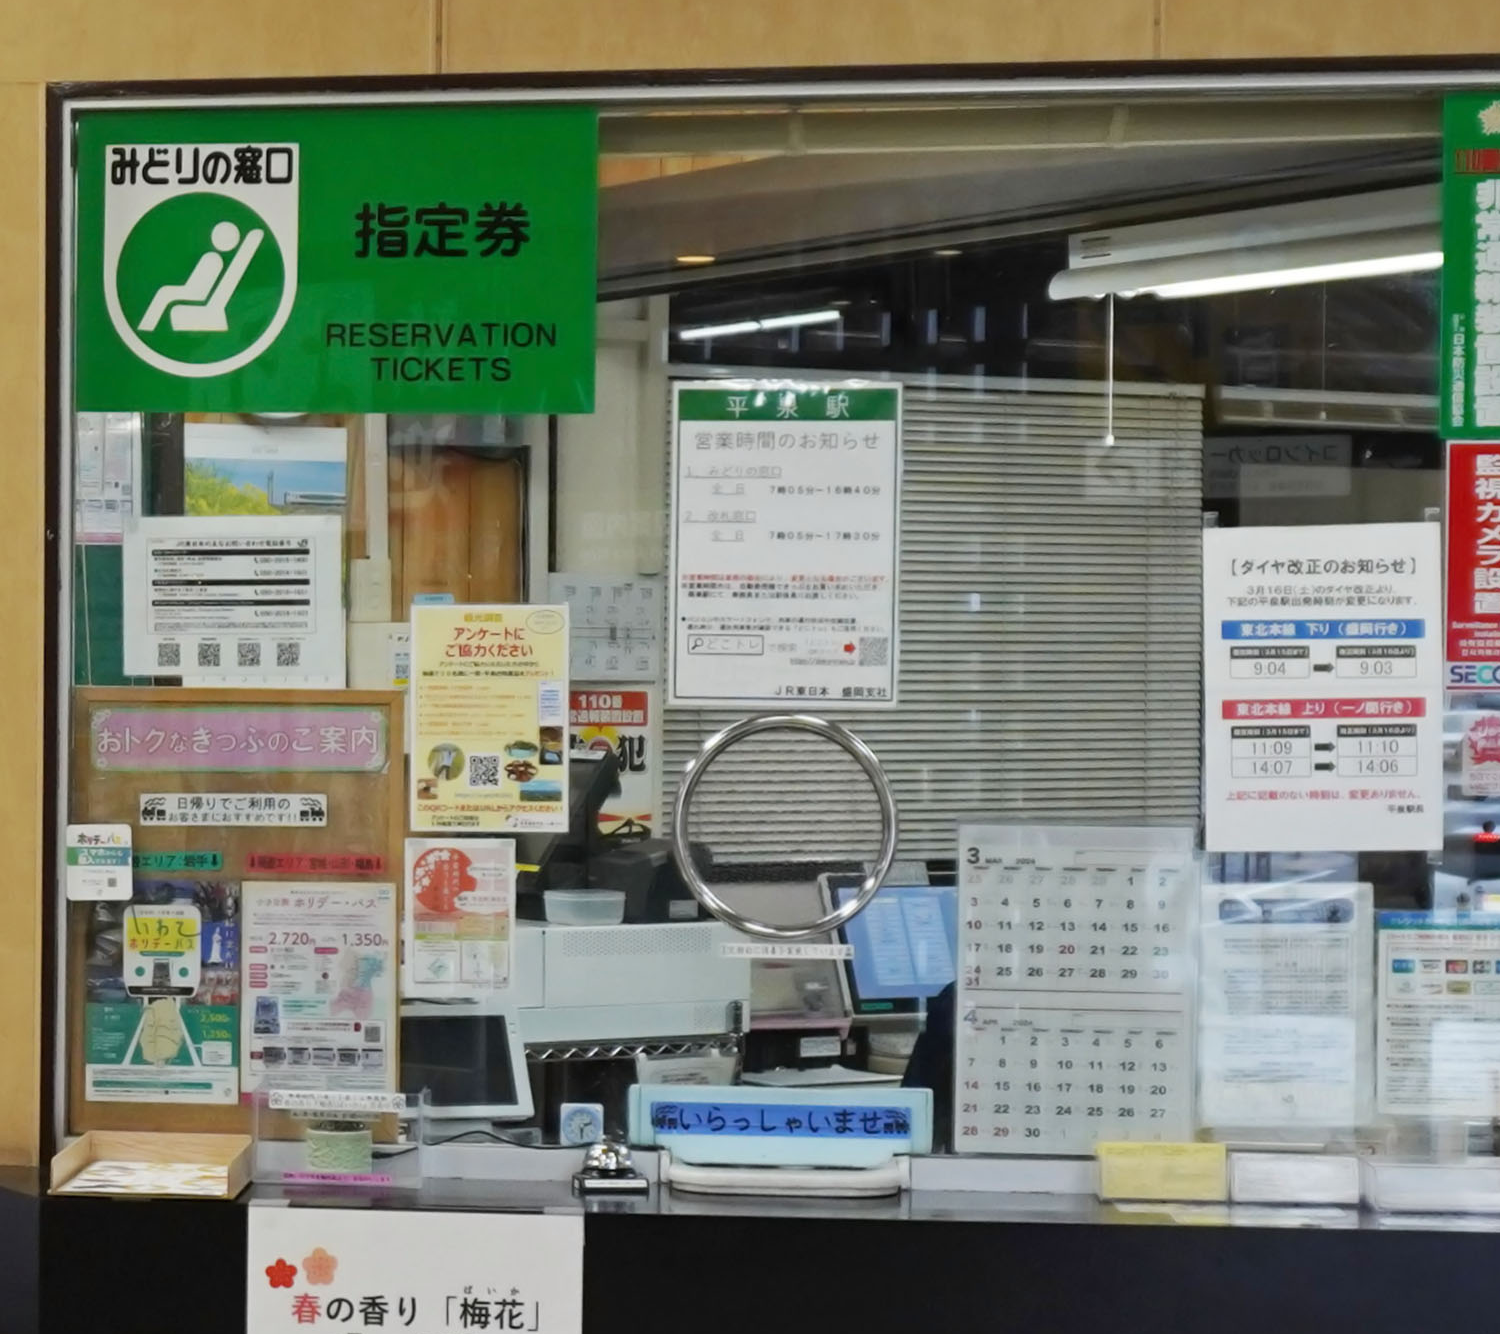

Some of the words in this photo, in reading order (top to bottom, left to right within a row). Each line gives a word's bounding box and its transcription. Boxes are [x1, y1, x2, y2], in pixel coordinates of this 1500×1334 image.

[111, 145, 294, 185] みどりの窓口
[354, 202, 531, 259] 指定券
[326, 322, 557, 348] RESERVATION
[371, 356, 512, 382] TICKETS
[694, 431, 881, 451] 営業時間のお知らせ
[453, 626, 526, 642] アンケートに
[445, 643, 534, 659] ご協力ください
[1253, 661, 1287, 676] 9:04
[1360, 661, 1393, 675] 9:03
[1302, 702, 1324, 715] 上り
[97, 726, 379, 757] おトクなきっぷのご案内
[1252, 741, 1292, 755] 11:09
[1357, 741, 1398, 754] 11:10
[1252, 760, 1292, 775] 14:07
[1357, 759, 1398, 773] 14:06
[176, 797, 291, 811] 日帰りでご利用の
[967, 848, 980, 864] 3
[1059, 944, 1075, 955] 20
[679, 1106, 883, 1135] いらっしゃいませ
[1025, 1127, 1040, 1139] 30
